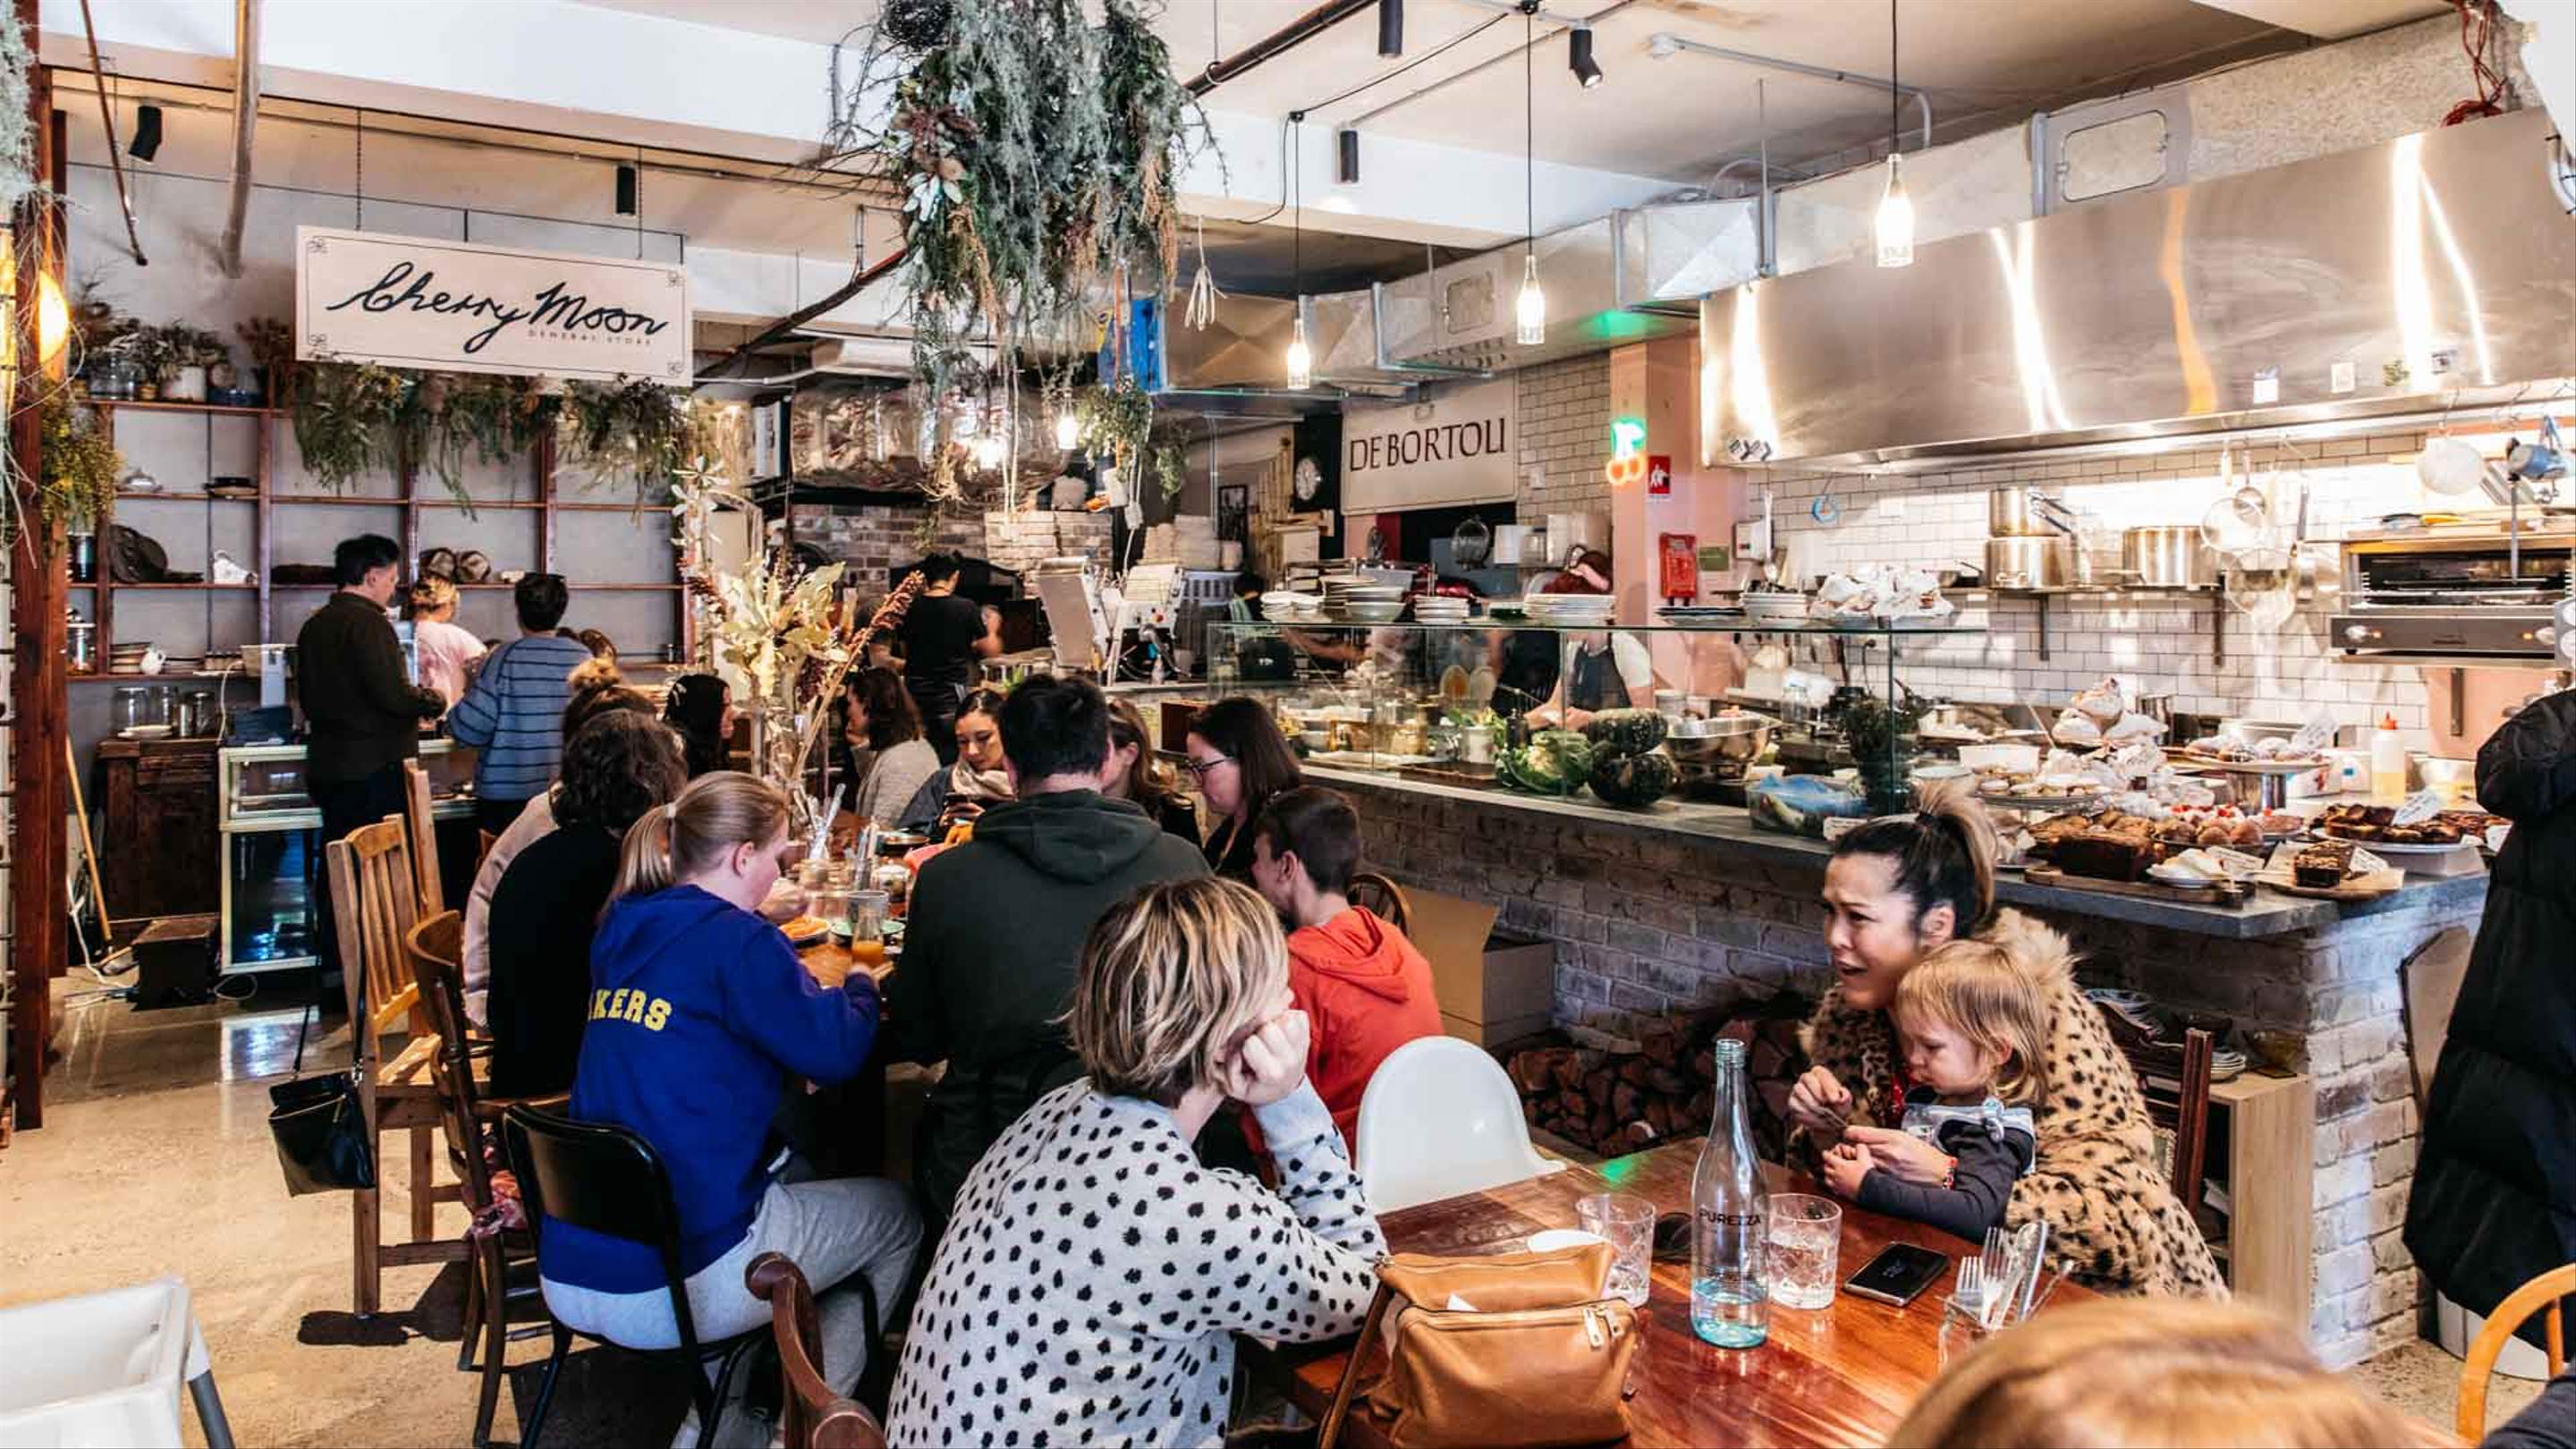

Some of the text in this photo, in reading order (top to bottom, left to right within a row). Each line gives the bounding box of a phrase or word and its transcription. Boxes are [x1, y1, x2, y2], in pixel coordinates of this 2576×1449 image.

[326, 260, 669, 354] Cherry Moon
[1350, 418, 1506, 473] DE BORTOLI
[589, 987, 673, 1031] KERS
